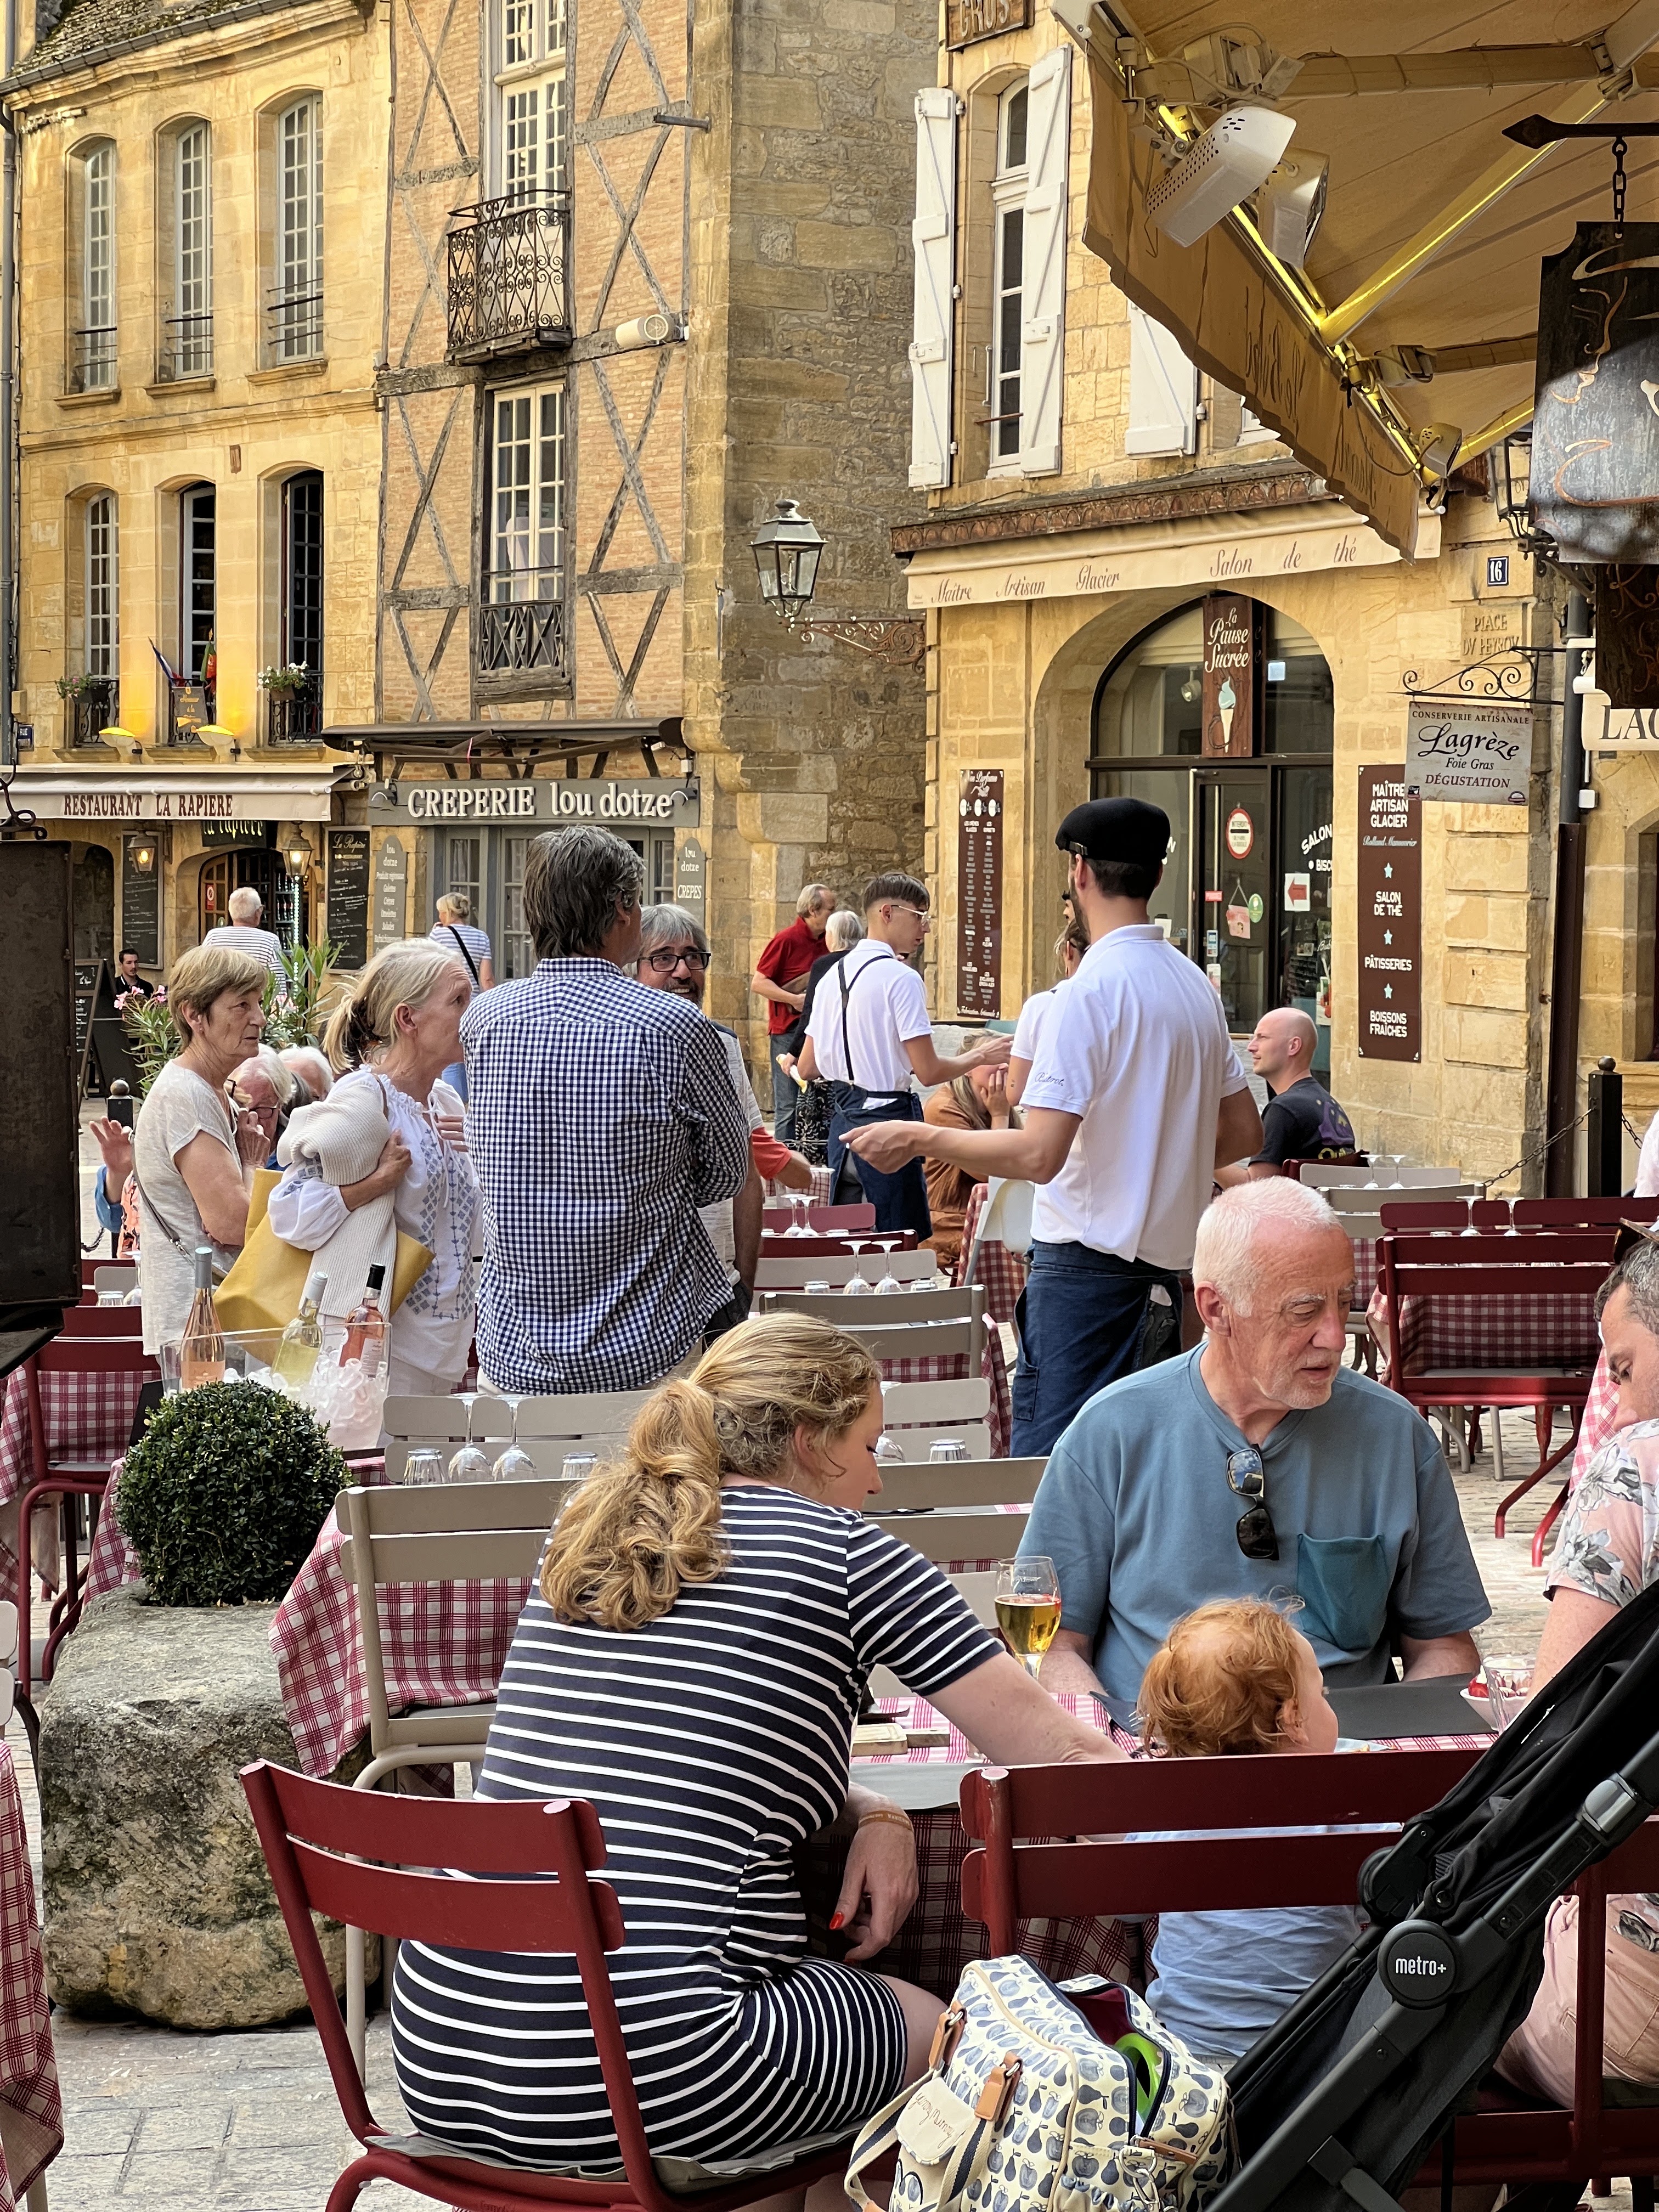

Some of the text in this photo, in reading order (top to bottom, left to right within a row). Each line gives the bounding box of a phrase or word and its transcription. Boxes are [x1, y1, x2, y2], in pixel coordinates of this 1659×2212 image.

[1210, 534, 1357, 577] Salon de thé
[1490, 560, 1502, 582] 16
[932, 565, 1120, 603] Maître Artisan Glacier
[1226, 607, 1238, 627] La
[1207, 617, 1250, 645] Pause
[1205, 643, 1250, 673] Sucrée
[1412, 710, 1529, 724] CONSERVERIE ARTISANALE
[1418, 722, 1520, 760] Lagrèze
[1446, 757, 1494, 770] Foie Gras
[1425, 772, 1510, 788] DÉGUSTATION
[1372, 780, 1405, 797] MAÎTRE
[64, 794, 233, 816] RESTAURANT LA RAPIERE
[408, 782, 673, 817] CREPERIE lou dotze
[1370, 799, 1408, 812] ARTISAN
[1370, 814, 1408, 828] GLACIER
[1301, 823, 1333, 855] SALON
[386, 844, 395, 854] lou
[685, 847, 696, 857] lou
[681, 861, 699, 872] dotze
[1316, 859, 1332, 871] BISC
[678, 884, 702, 899] CREPES
[1376, 890, 1401, 903] SALON
[1374, 904, 1385, 916] DE
[1364, 954, 1412, 972] PÂTISSERIES
[1370, 1010, 1407, 1025] BOISSONS
[1370, 1022, 1408, 1038] FRAÎCHES
[1396, 1956, 1447, 1976] metro+
